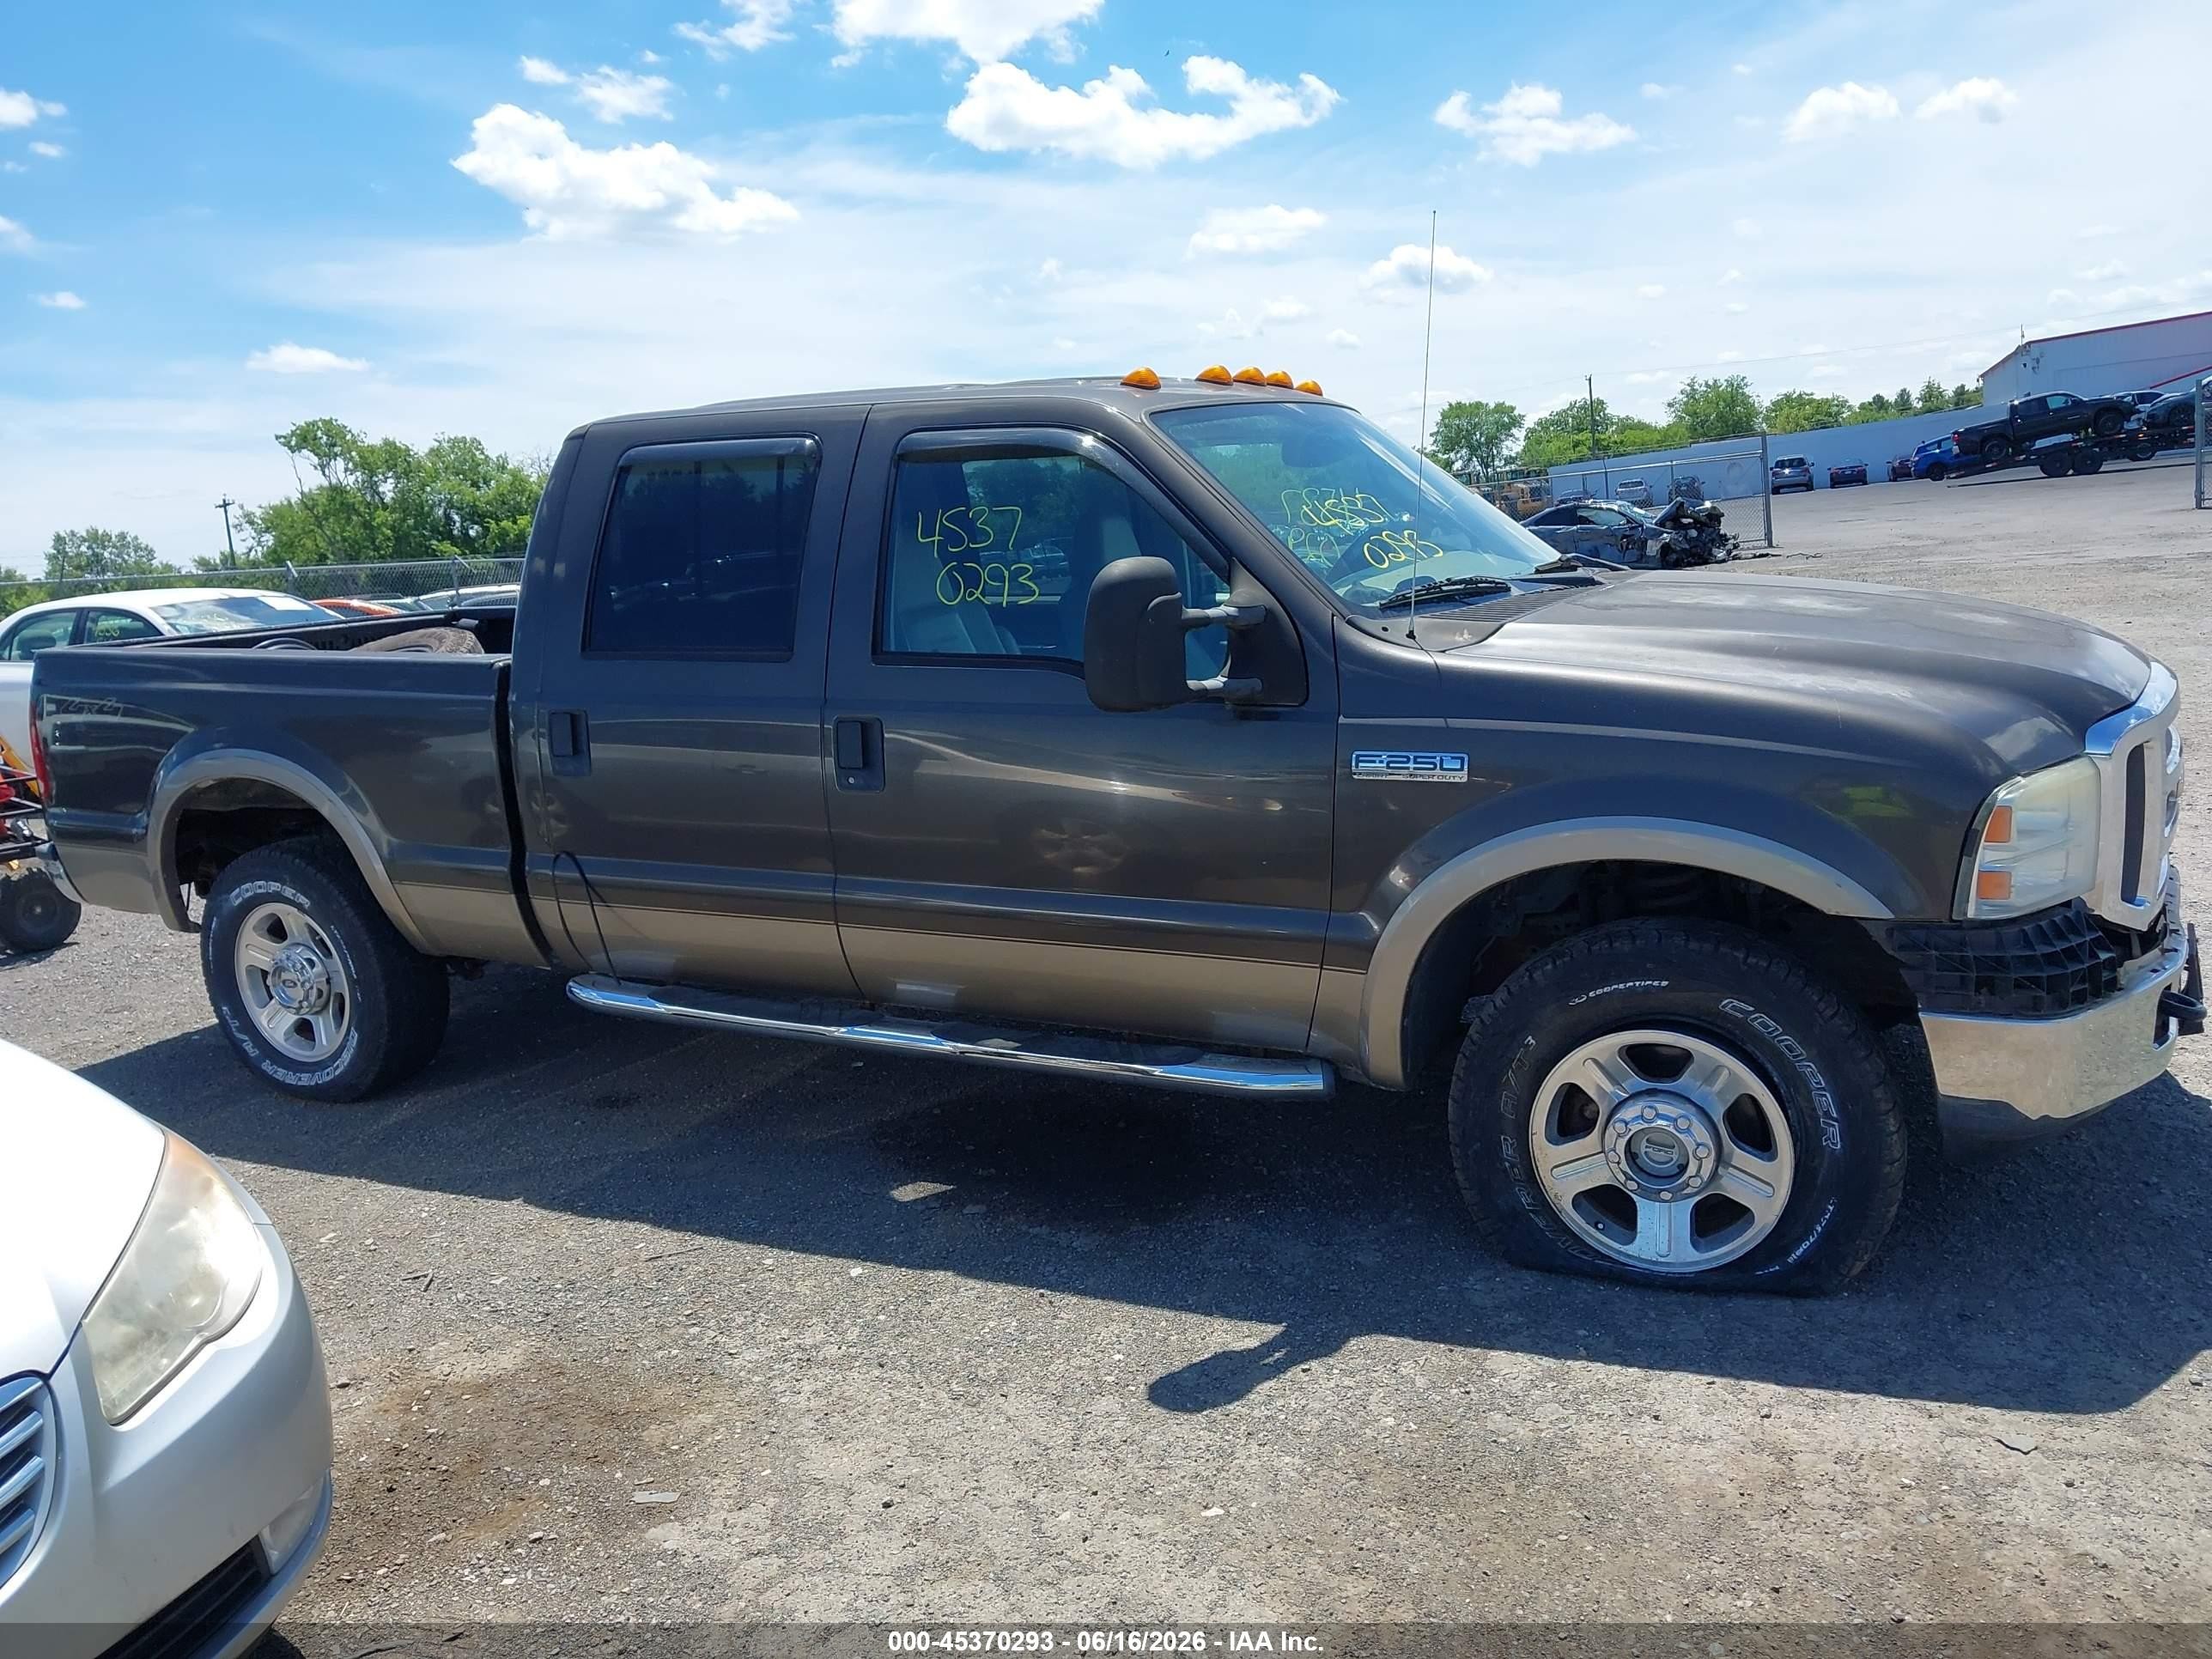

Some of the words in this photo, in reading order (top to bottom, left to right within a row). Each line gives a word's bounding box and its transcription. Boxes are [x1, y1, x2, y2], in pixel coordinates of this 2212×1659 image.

[916, 506, 1023, 559] 4537
[1363, 529, 1444, 568] 0293
[935, 562, 1041, 608] 0293
[228, 880, 312, 908] COOPER
[261, 1026, 358, 1086] DISCOVERER
[1718, 998, 1841, 1150] COOPER
